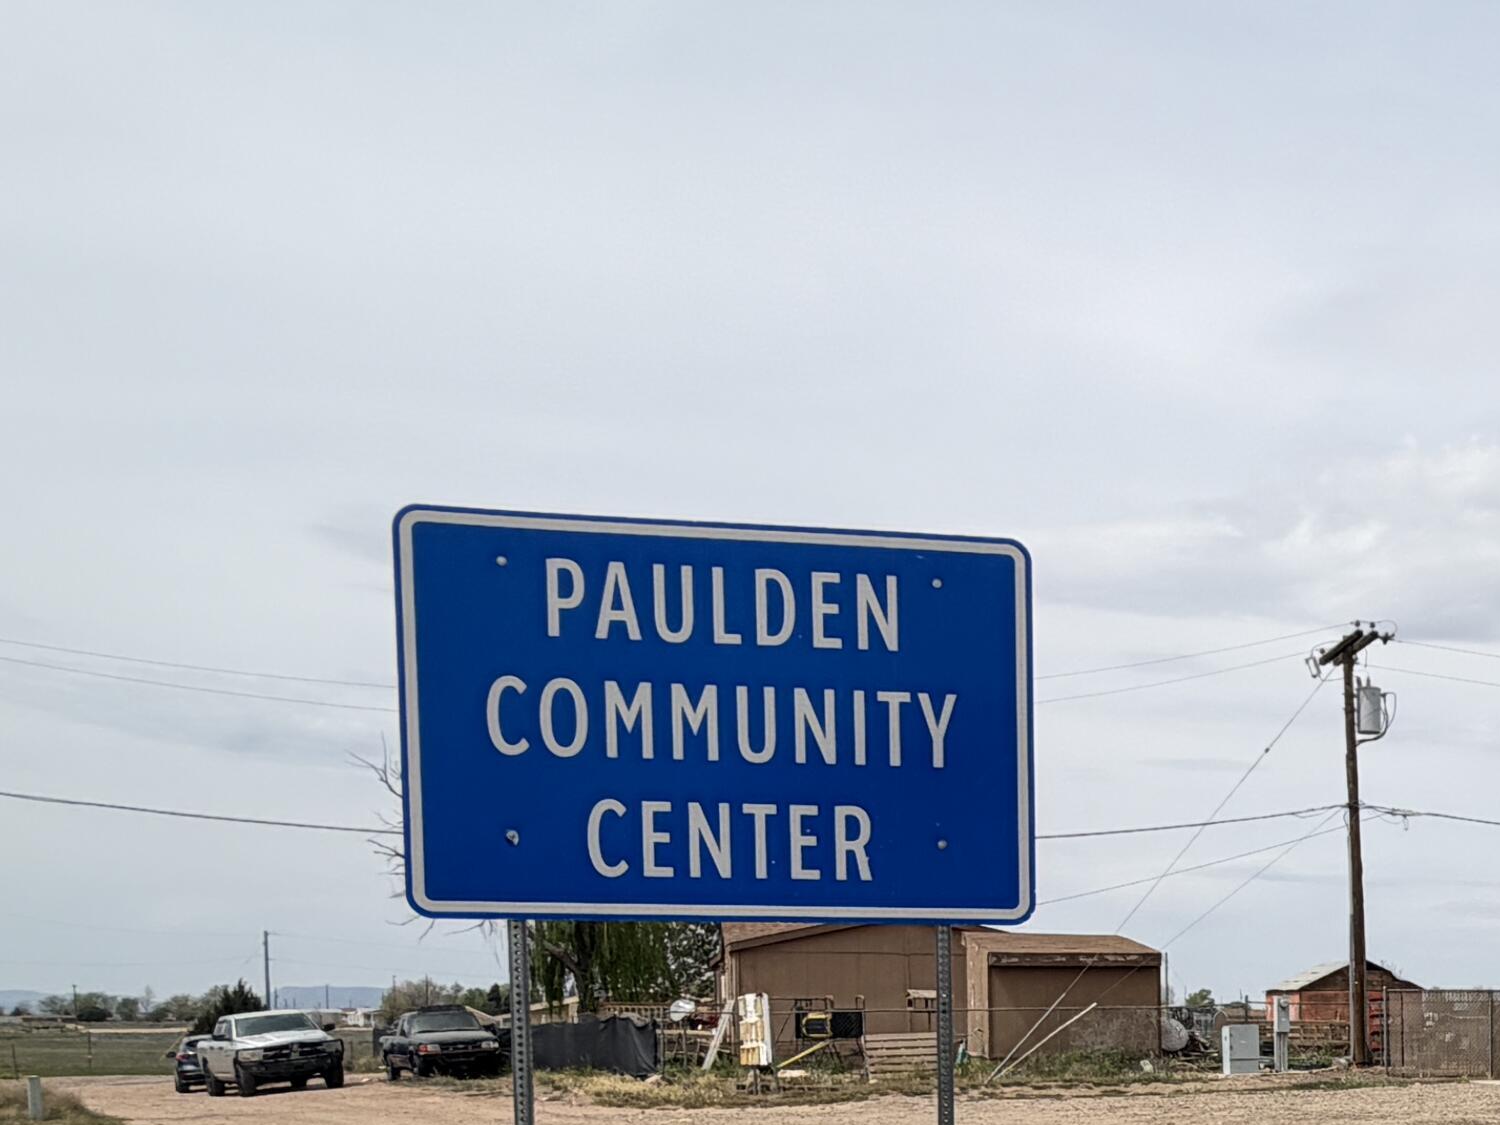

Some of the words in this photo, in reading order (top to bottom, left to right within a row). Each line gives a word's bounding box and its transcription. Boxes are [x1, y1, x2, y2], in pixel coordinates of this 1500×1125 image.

[545, 558, 899, 652] PAULDEN
[486, 675, 957, 768] COMMUNITY
[587, 798, 873, 882] CENTER
